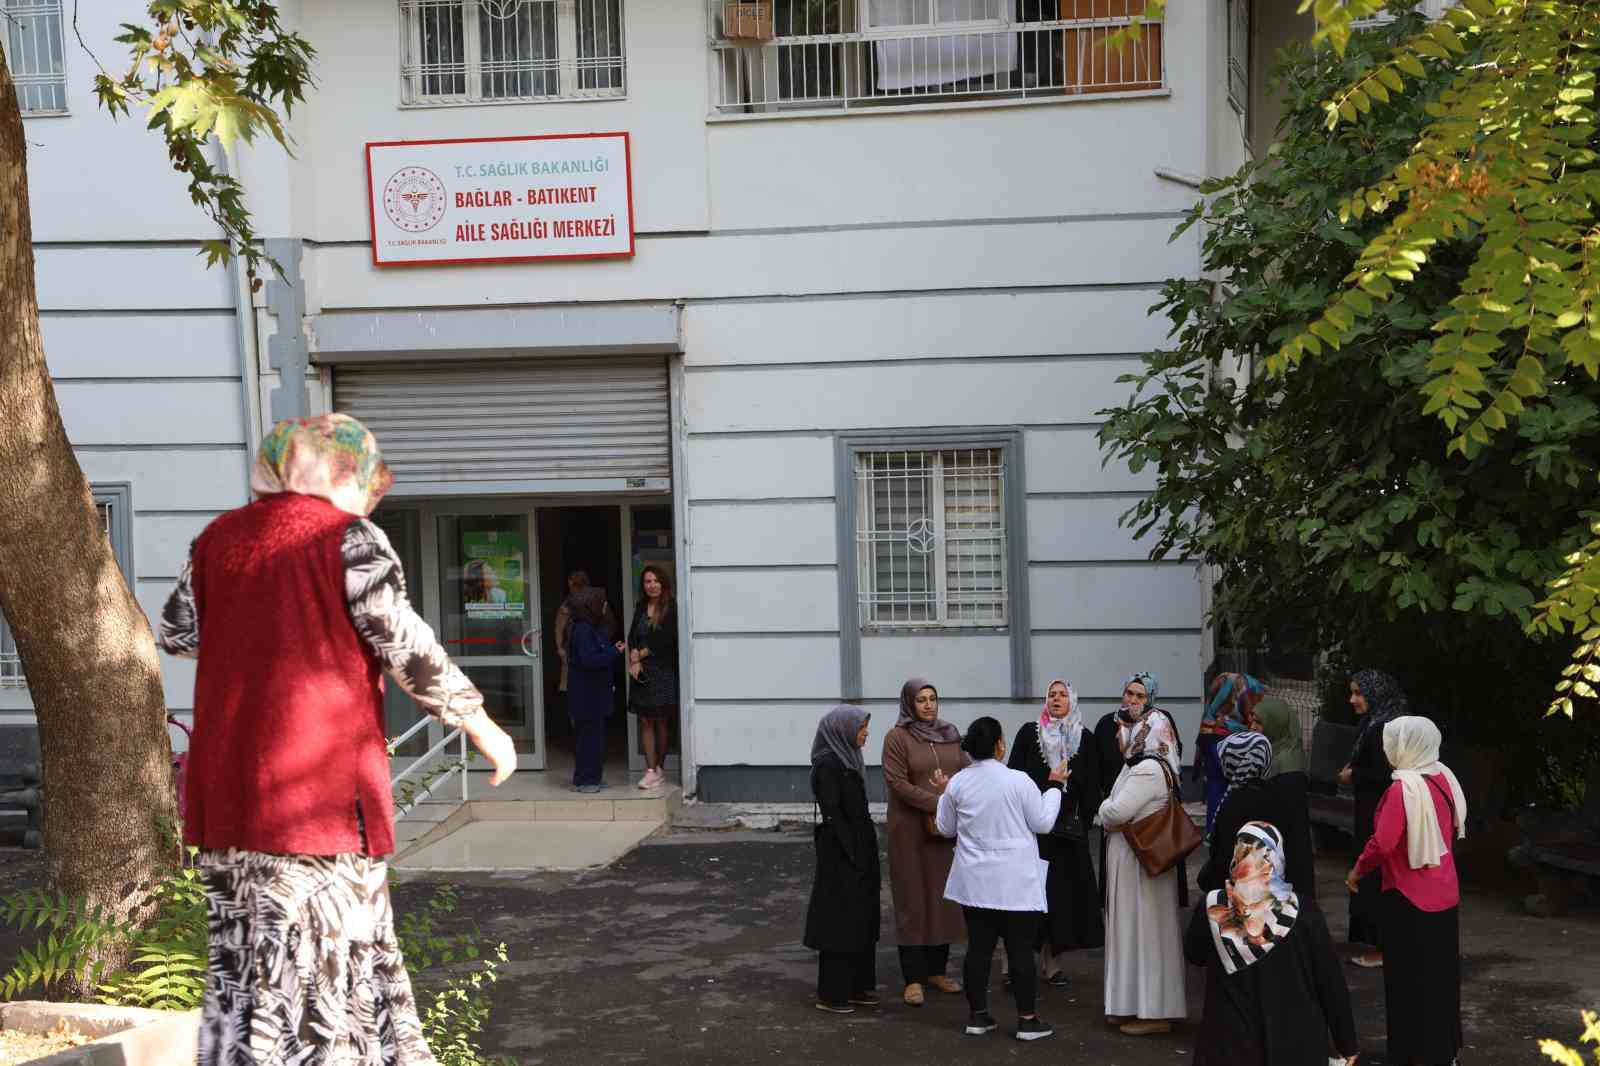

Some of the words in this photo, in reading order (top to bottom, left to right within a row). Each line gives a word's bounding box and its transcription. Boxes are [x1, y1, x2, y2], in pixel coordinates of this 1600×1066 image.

[455, 166, 476, 178] T.C.
[480, 159, 528, 177] SAĞLIK
[532, 156, 609, 175] BAKANLIĞI
[455, 187, 512, 208] BAĞLAR
[527, 186, 597, 206] BATIKENT
[455, 219, 486, 242] AİLE
[491, 217, 548, 240] SAĞLIĞI
[553, 213, 616, 238] MERKEZİ
